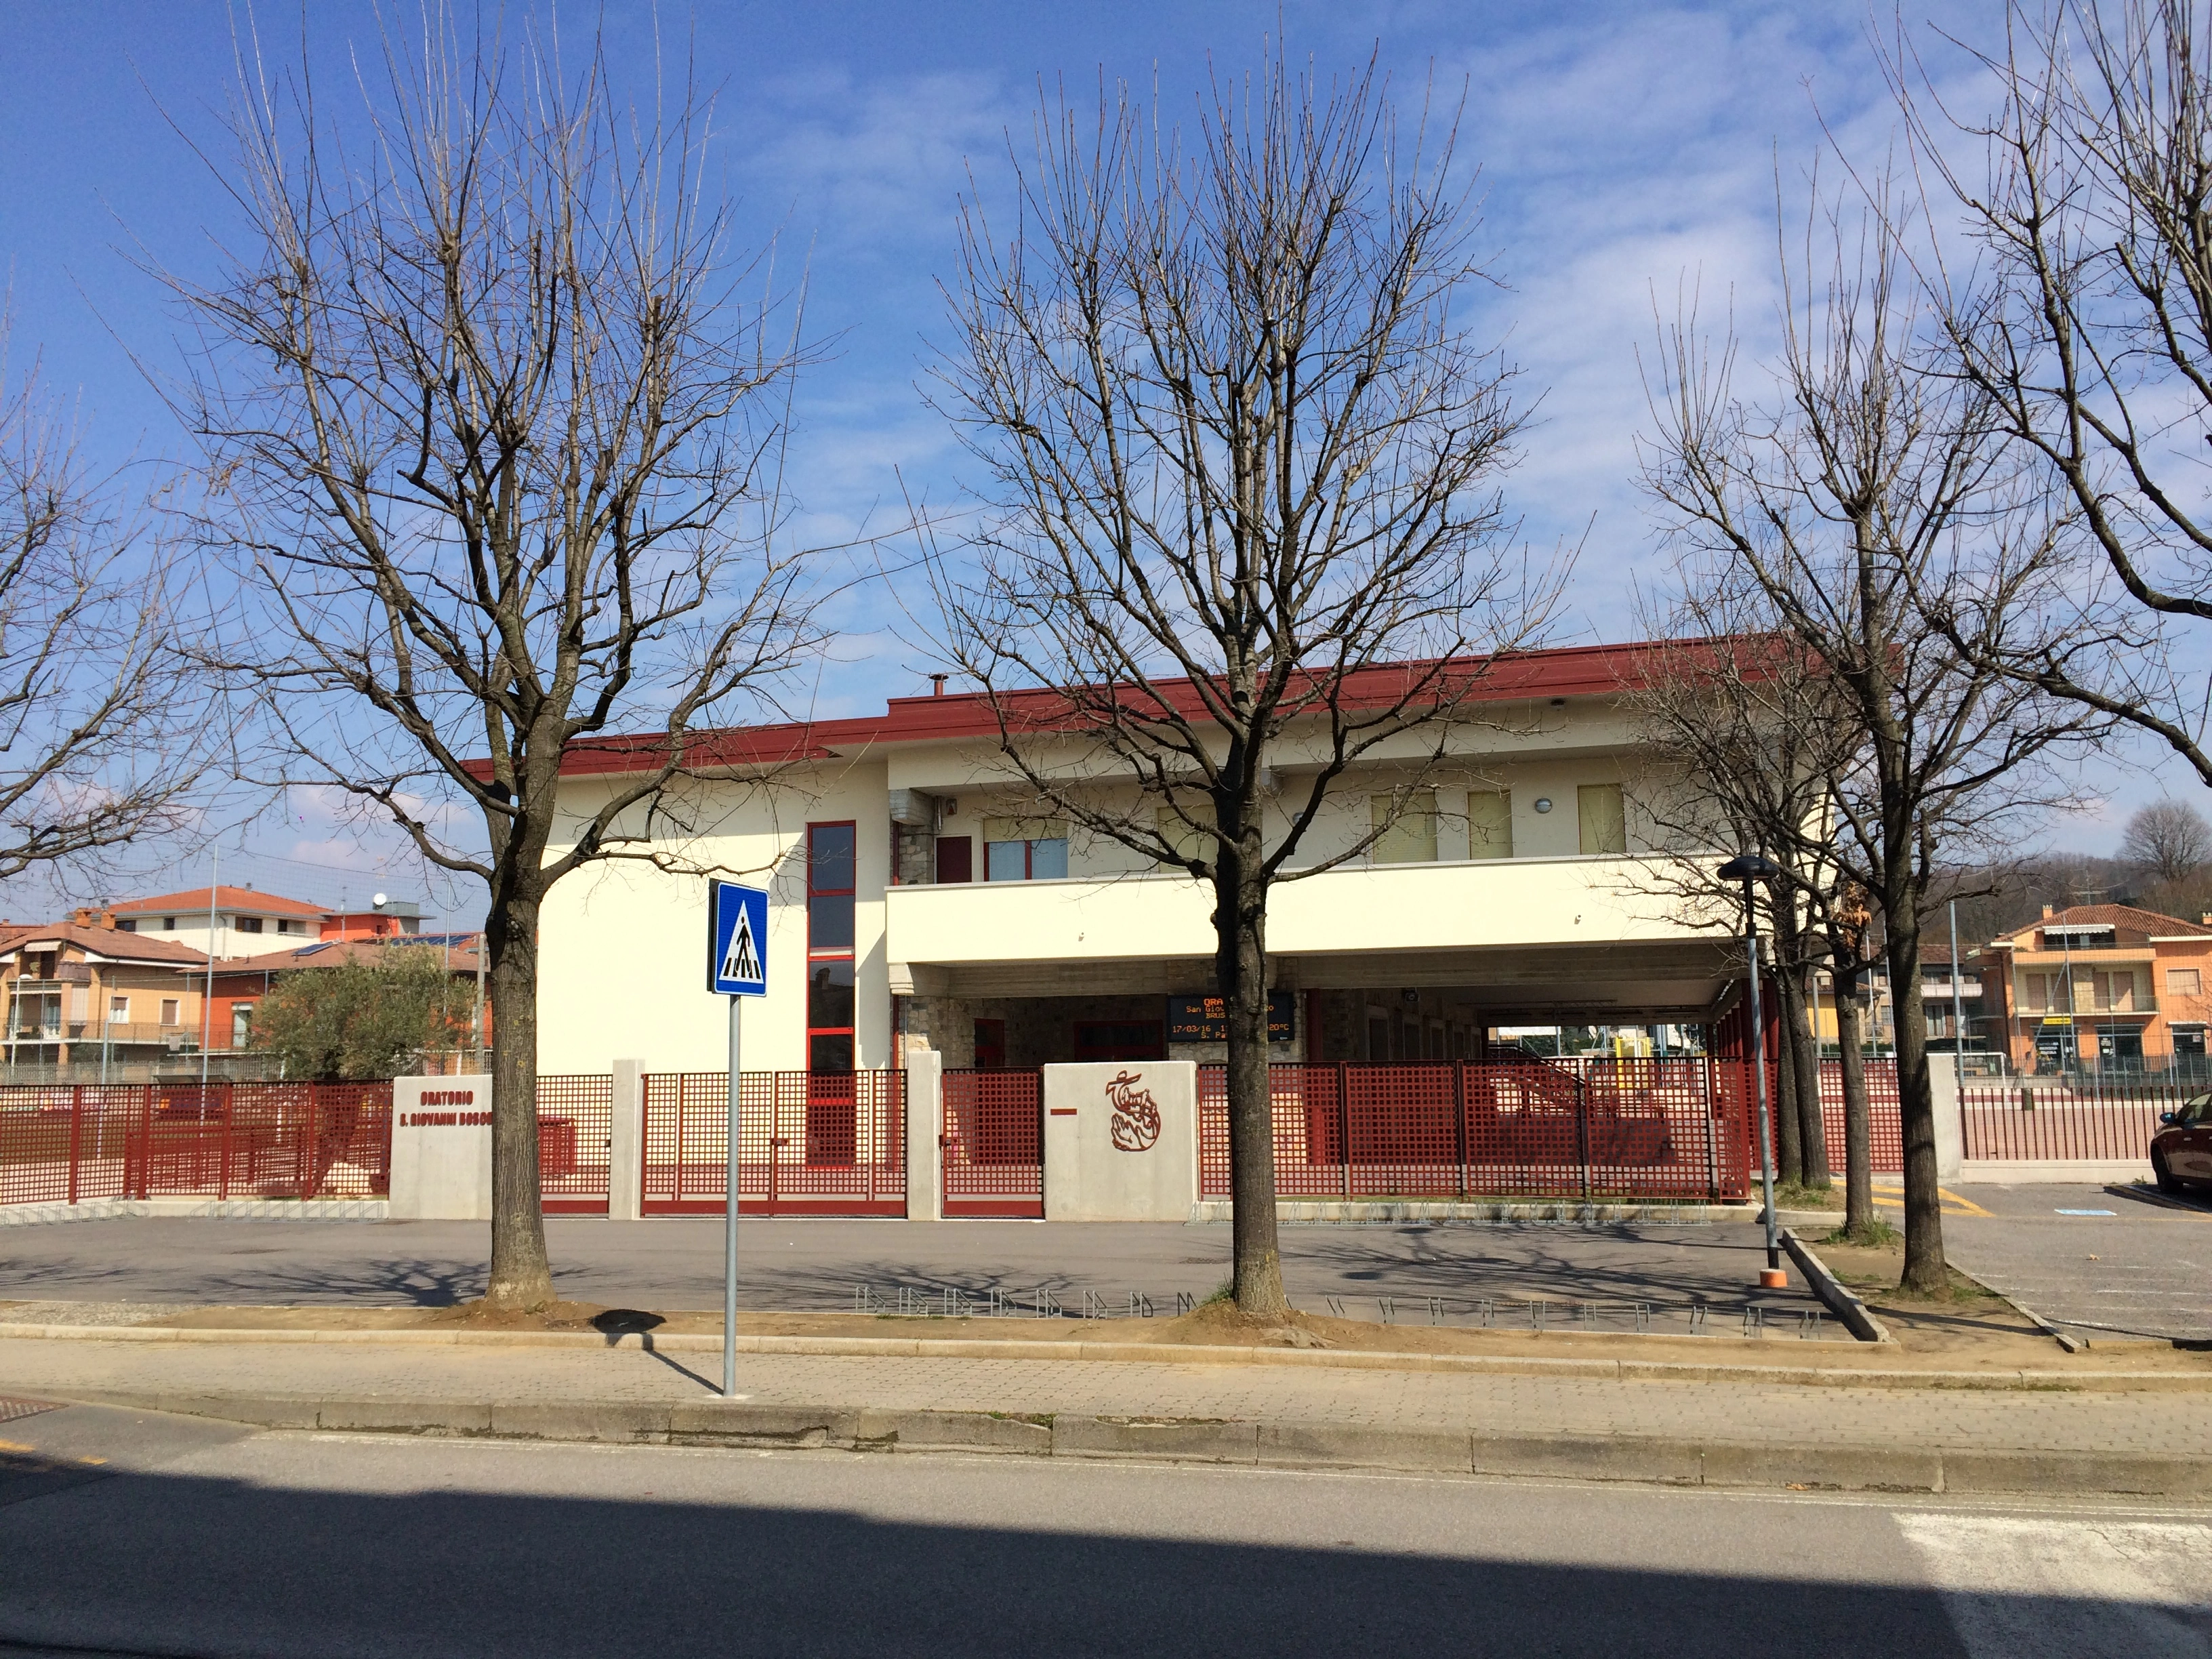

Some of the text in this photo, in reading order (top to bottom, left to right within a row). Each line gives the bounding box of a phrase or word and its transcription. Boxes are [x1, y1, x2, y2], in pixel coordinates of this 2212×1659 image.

[1172, 1025, 1211, 1033] 17/03/16
[420, 1090, 474, 1106] ORATORIO
[410, 1112, 457, 1126] GIOVANNI
[459, 1111, 493, 1126] BOSCO
